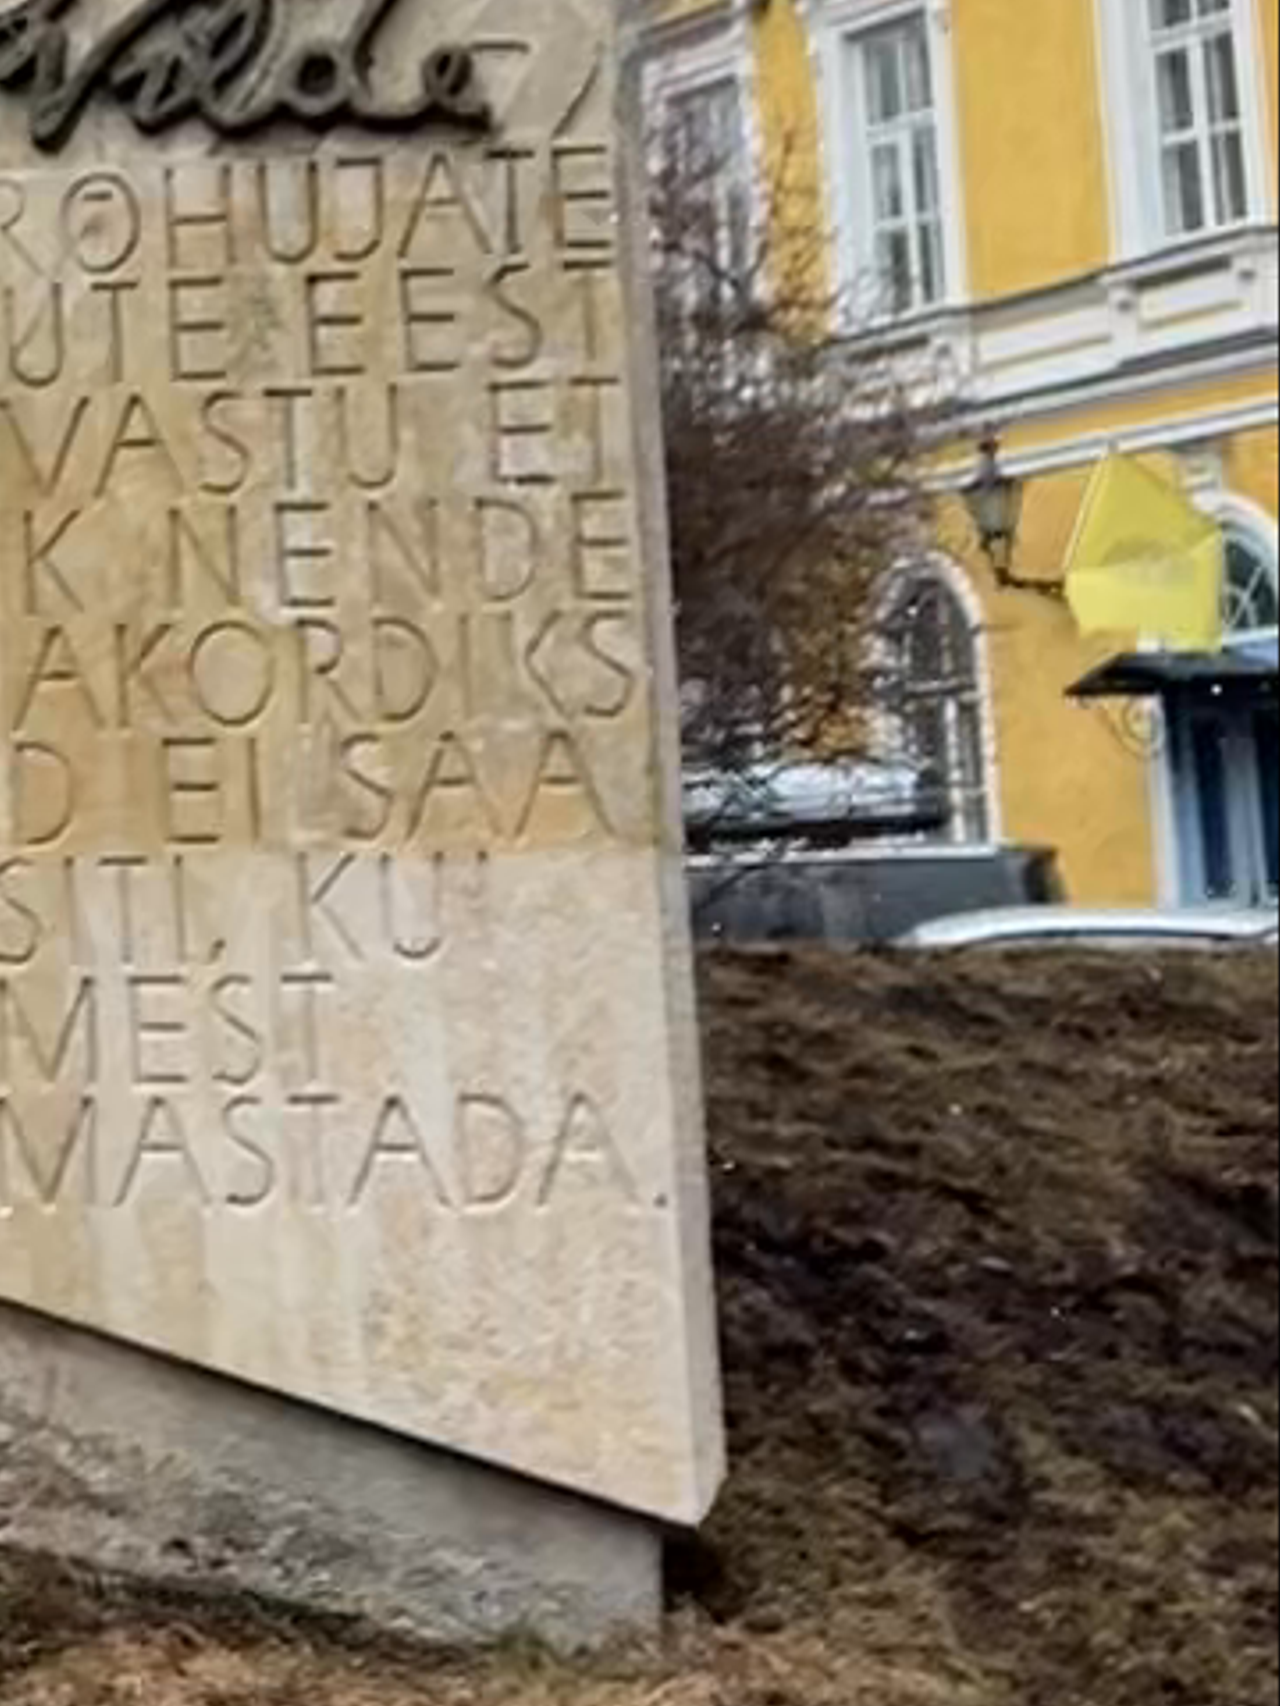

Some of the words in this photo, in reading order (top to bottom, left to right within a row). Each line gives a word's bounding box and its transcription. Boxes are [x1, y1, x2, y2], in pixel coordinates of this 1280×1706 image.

[306, 260, 610, 378] EEST
[490, 376, 620, 488] ET
[168, 492, 632, 608] NENDE
[12, 610, 636, 731] AKORDIKS
[162, 734, 262, 844] EI
[338, 728, 618, 841] SAA
